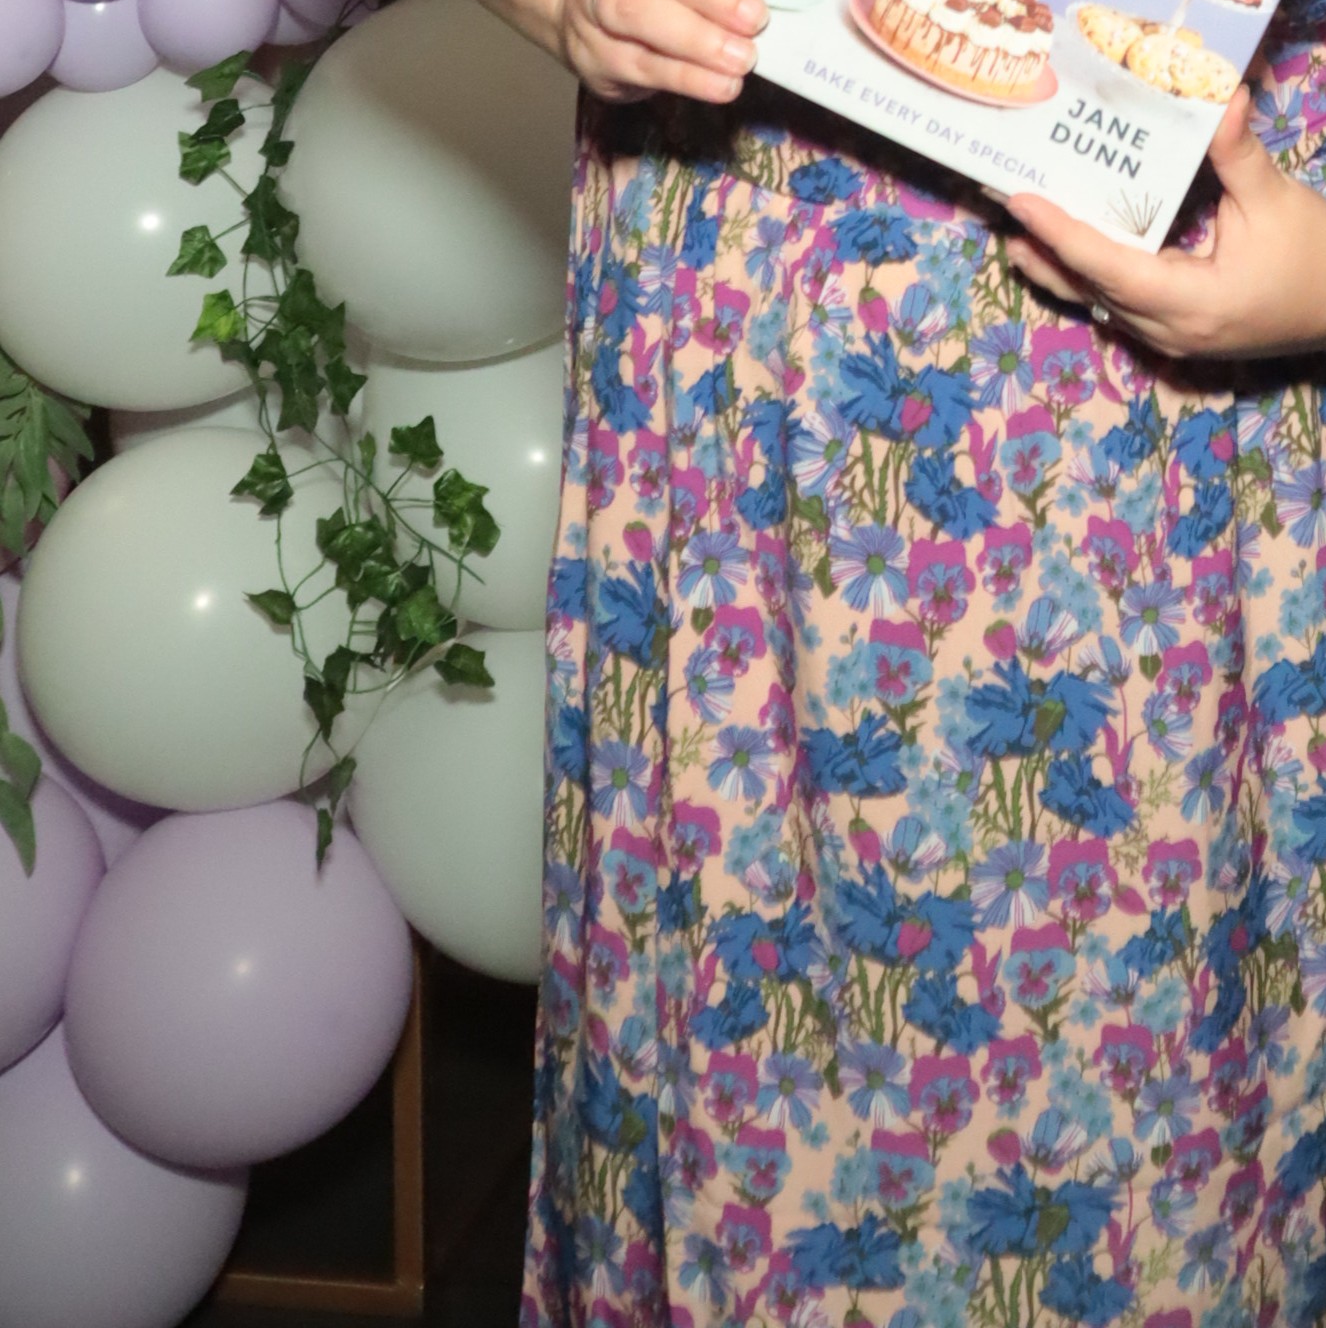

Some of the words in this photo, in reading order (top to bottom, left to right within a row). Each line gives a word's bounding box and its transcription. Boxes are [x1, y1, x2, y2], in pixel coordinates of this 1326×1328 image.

[804, 59, 853, 94] BAKE
[860, 87, 922, 125] EVERY
[926, 119, 965, 146] DAY
[968, 139, 1047, 189] SPECIAL
[1049, 122, 1142, 179] DUNN
[1067, 98, 1151, 150] JANE
